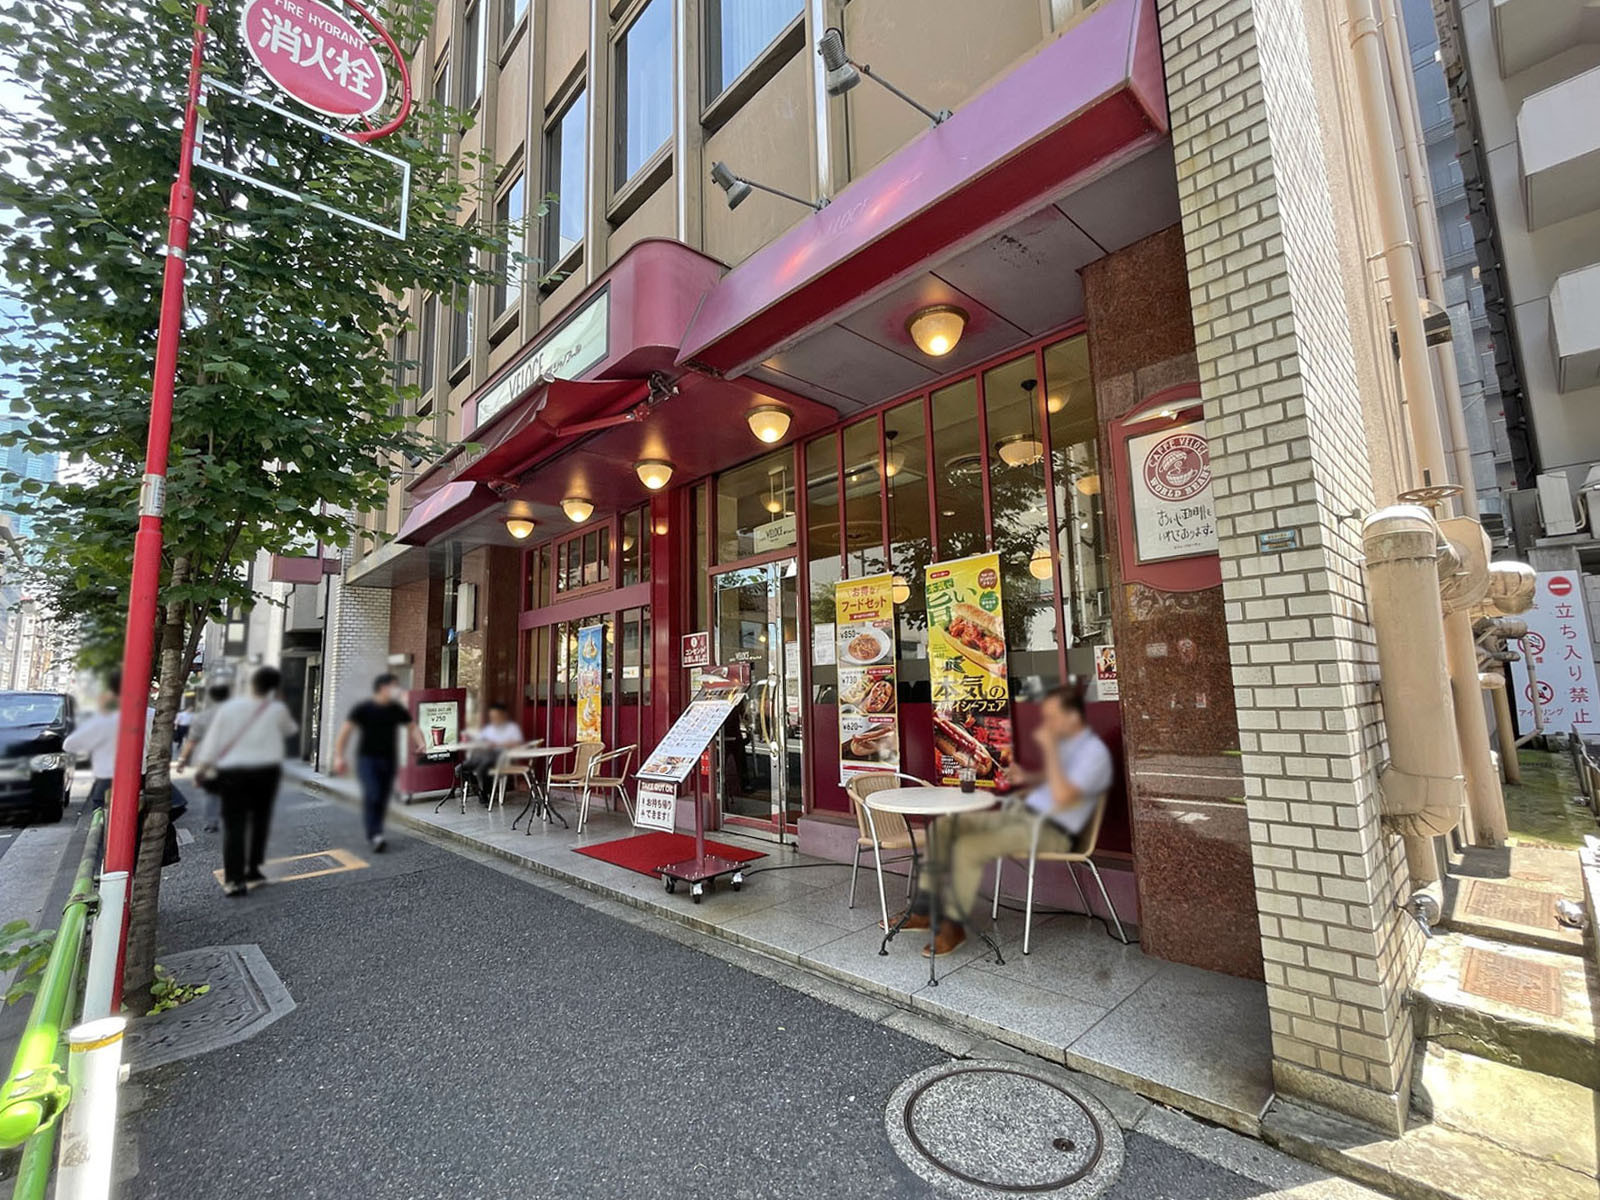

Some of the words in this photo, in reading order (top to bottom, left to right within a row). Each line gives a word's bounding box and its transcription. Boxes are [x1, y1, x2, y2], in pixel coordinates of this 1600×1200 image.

[275, 0, 304, 18] FIRE
[308, 12, 365, 50] HYDRANT
[258, 7, 375, 100] 消火栓
[1150, 476, 1182, 497] WORLD
[841, 596, 887, 613] フードセット
[1555, 602, 1593, 724] 立ち入り禁止
[933, 699, 1006, 712] スパイシーフェア
[1519, 708, 1564, 717] アイリング
